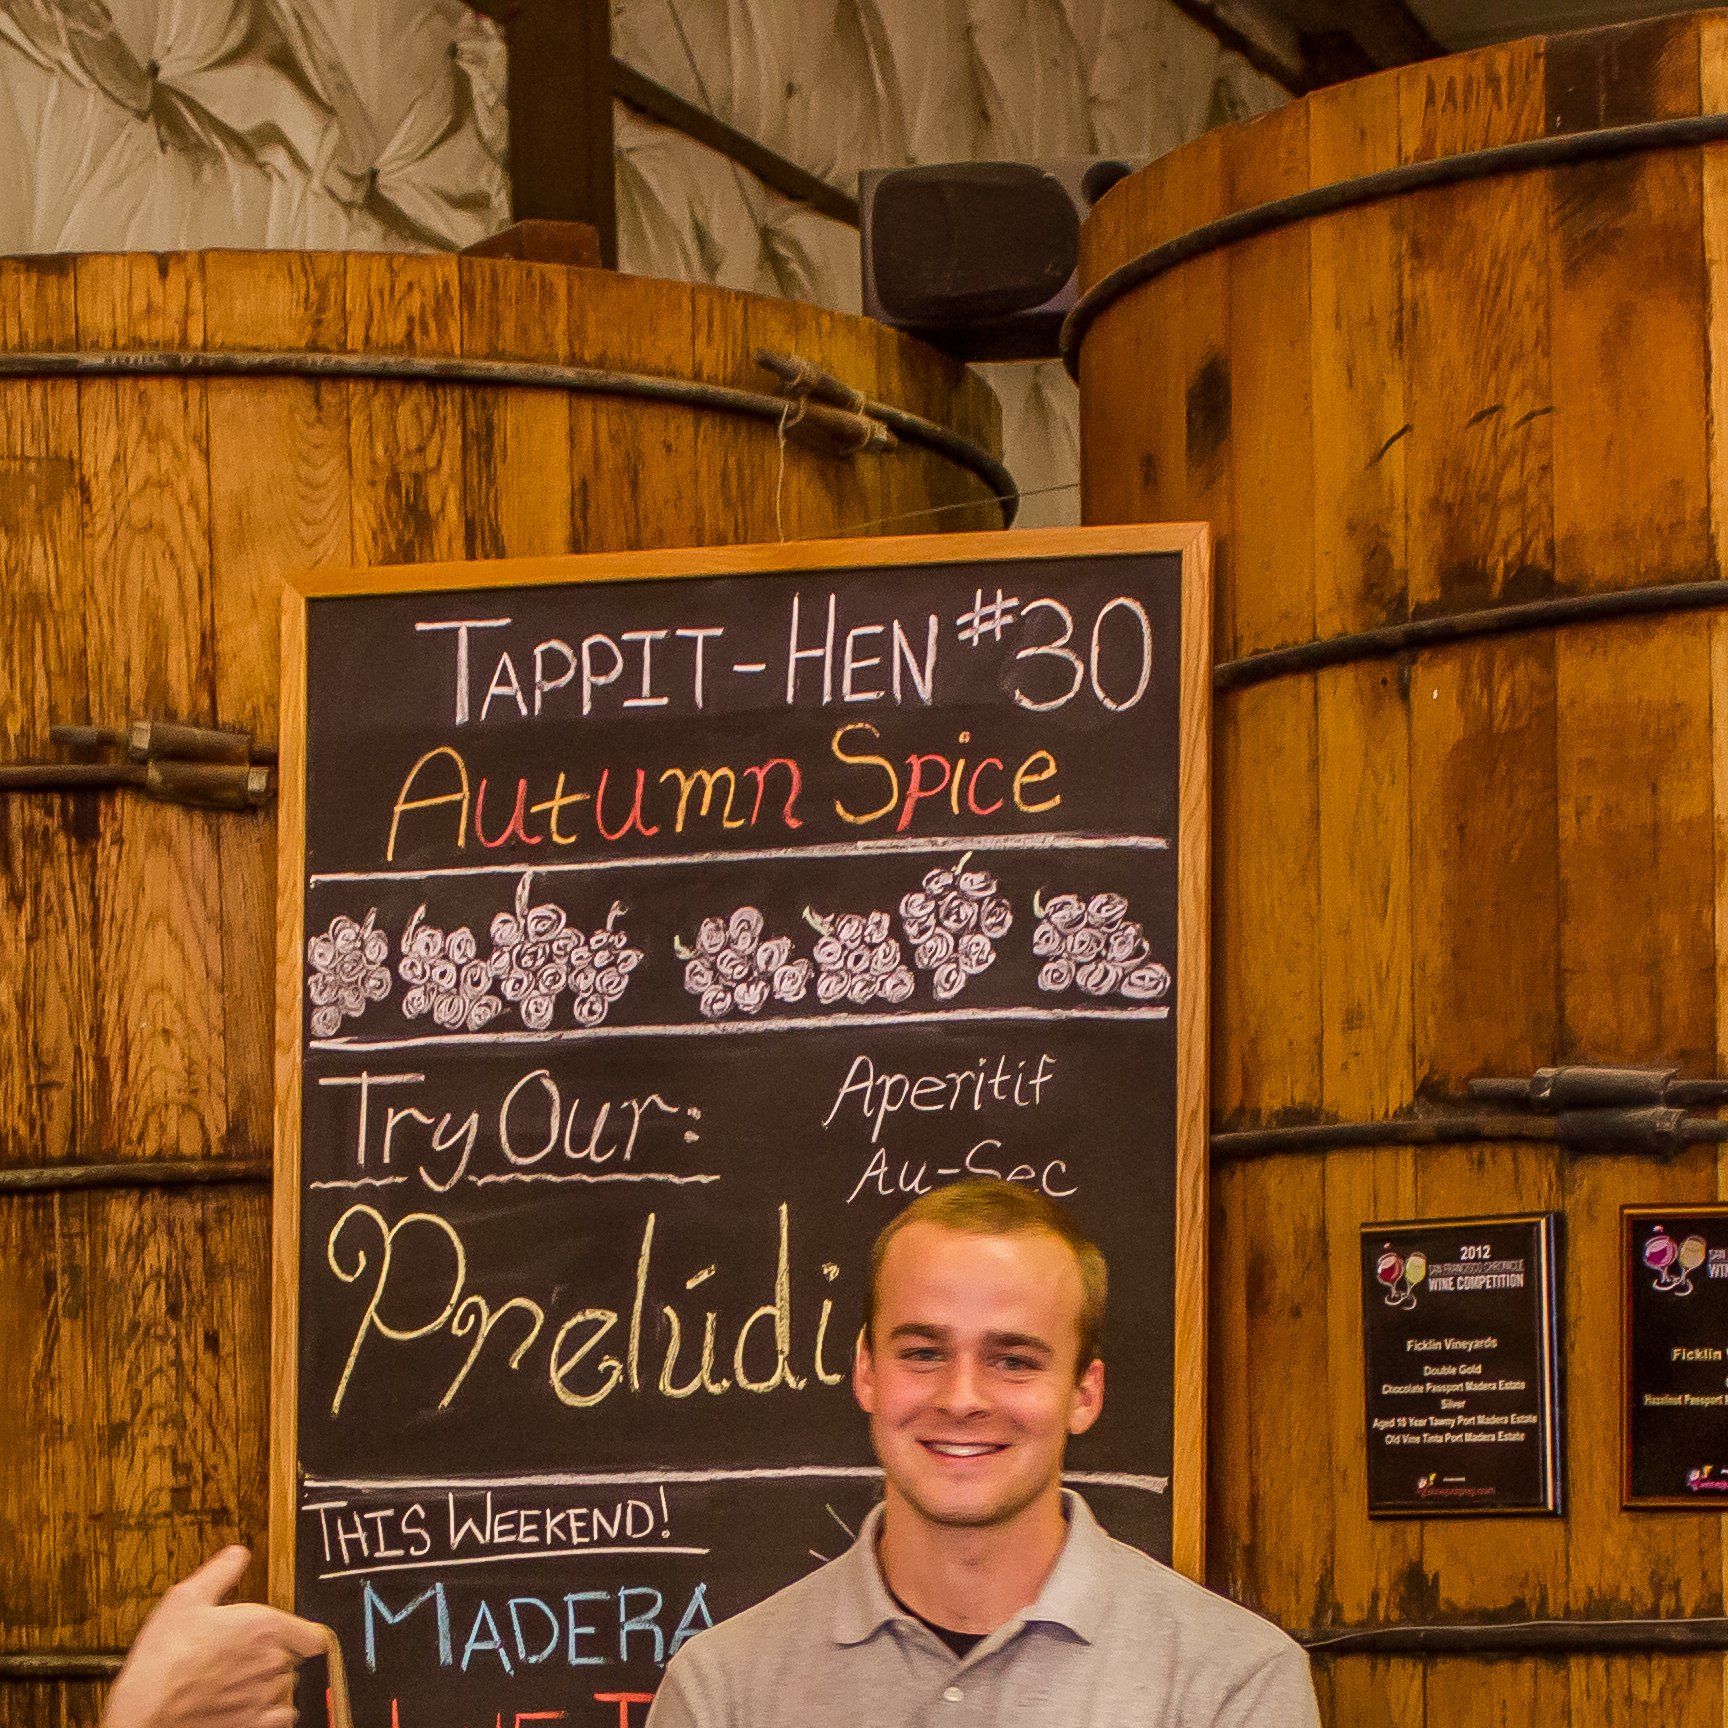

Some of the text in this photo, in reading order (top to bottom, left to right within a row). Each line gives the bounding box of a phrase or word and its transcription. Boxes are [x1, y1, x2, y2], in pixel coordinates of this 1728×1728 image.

[958, 589, 1152, 712] #30
[388, 723, 1062, 860] Autumn Spice
[319, 1068, 703, 1192] Try Our:
[822, 1054, 1057, 1143] Aperitif
[846, 1139, 1078, 1204] Au-Sec
[1429, 1274, 1524, 1292] WINE COMPETITION
[1460, 1245, 1491, 1260] 2012
[328, 1201, 848, 1417] Prelúdi
[1407, 1337, 1498, 1352] Ficklin Vineyards
[1424, 1364, 1482, 1376] Double Gold
[1672, 1348, 1722, 1361] Ficklin
[1373, 1418, 1395, 1430] Aged
[1457, 1415, 1476, 1426] Port
[1444, 1432, 1463, 1443] Port
[302, 1485, 670, 1563] THIS WEEKEND!
[360, 1579, 714, 1676] MADERA
